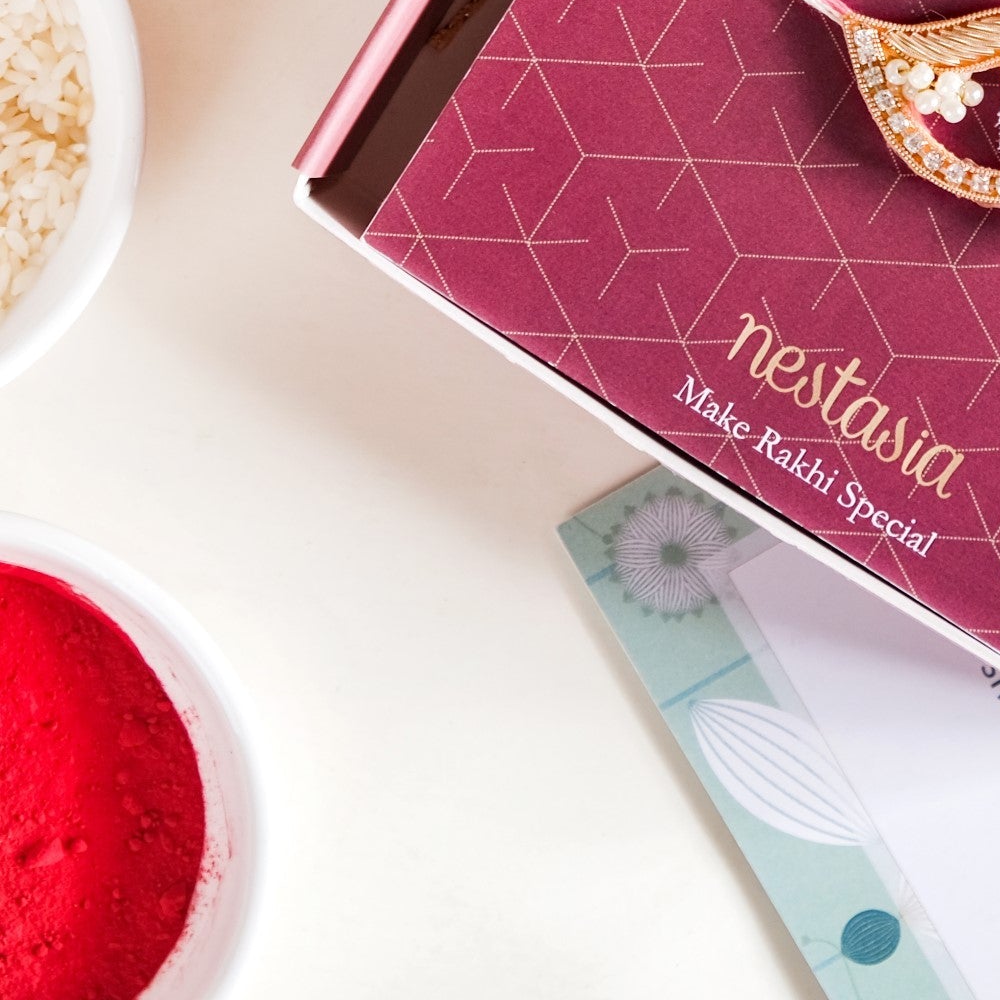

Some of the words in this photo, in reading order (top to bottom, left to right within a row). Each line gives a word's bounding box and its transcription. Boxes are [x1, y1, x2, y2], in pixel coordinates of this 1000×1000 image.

[672, 374, 751, 440] Make
[752, 425, 840, 495] Rakhi
[836, 481, 938, 558] Special
[727, 313, 965, 500] nestasia
